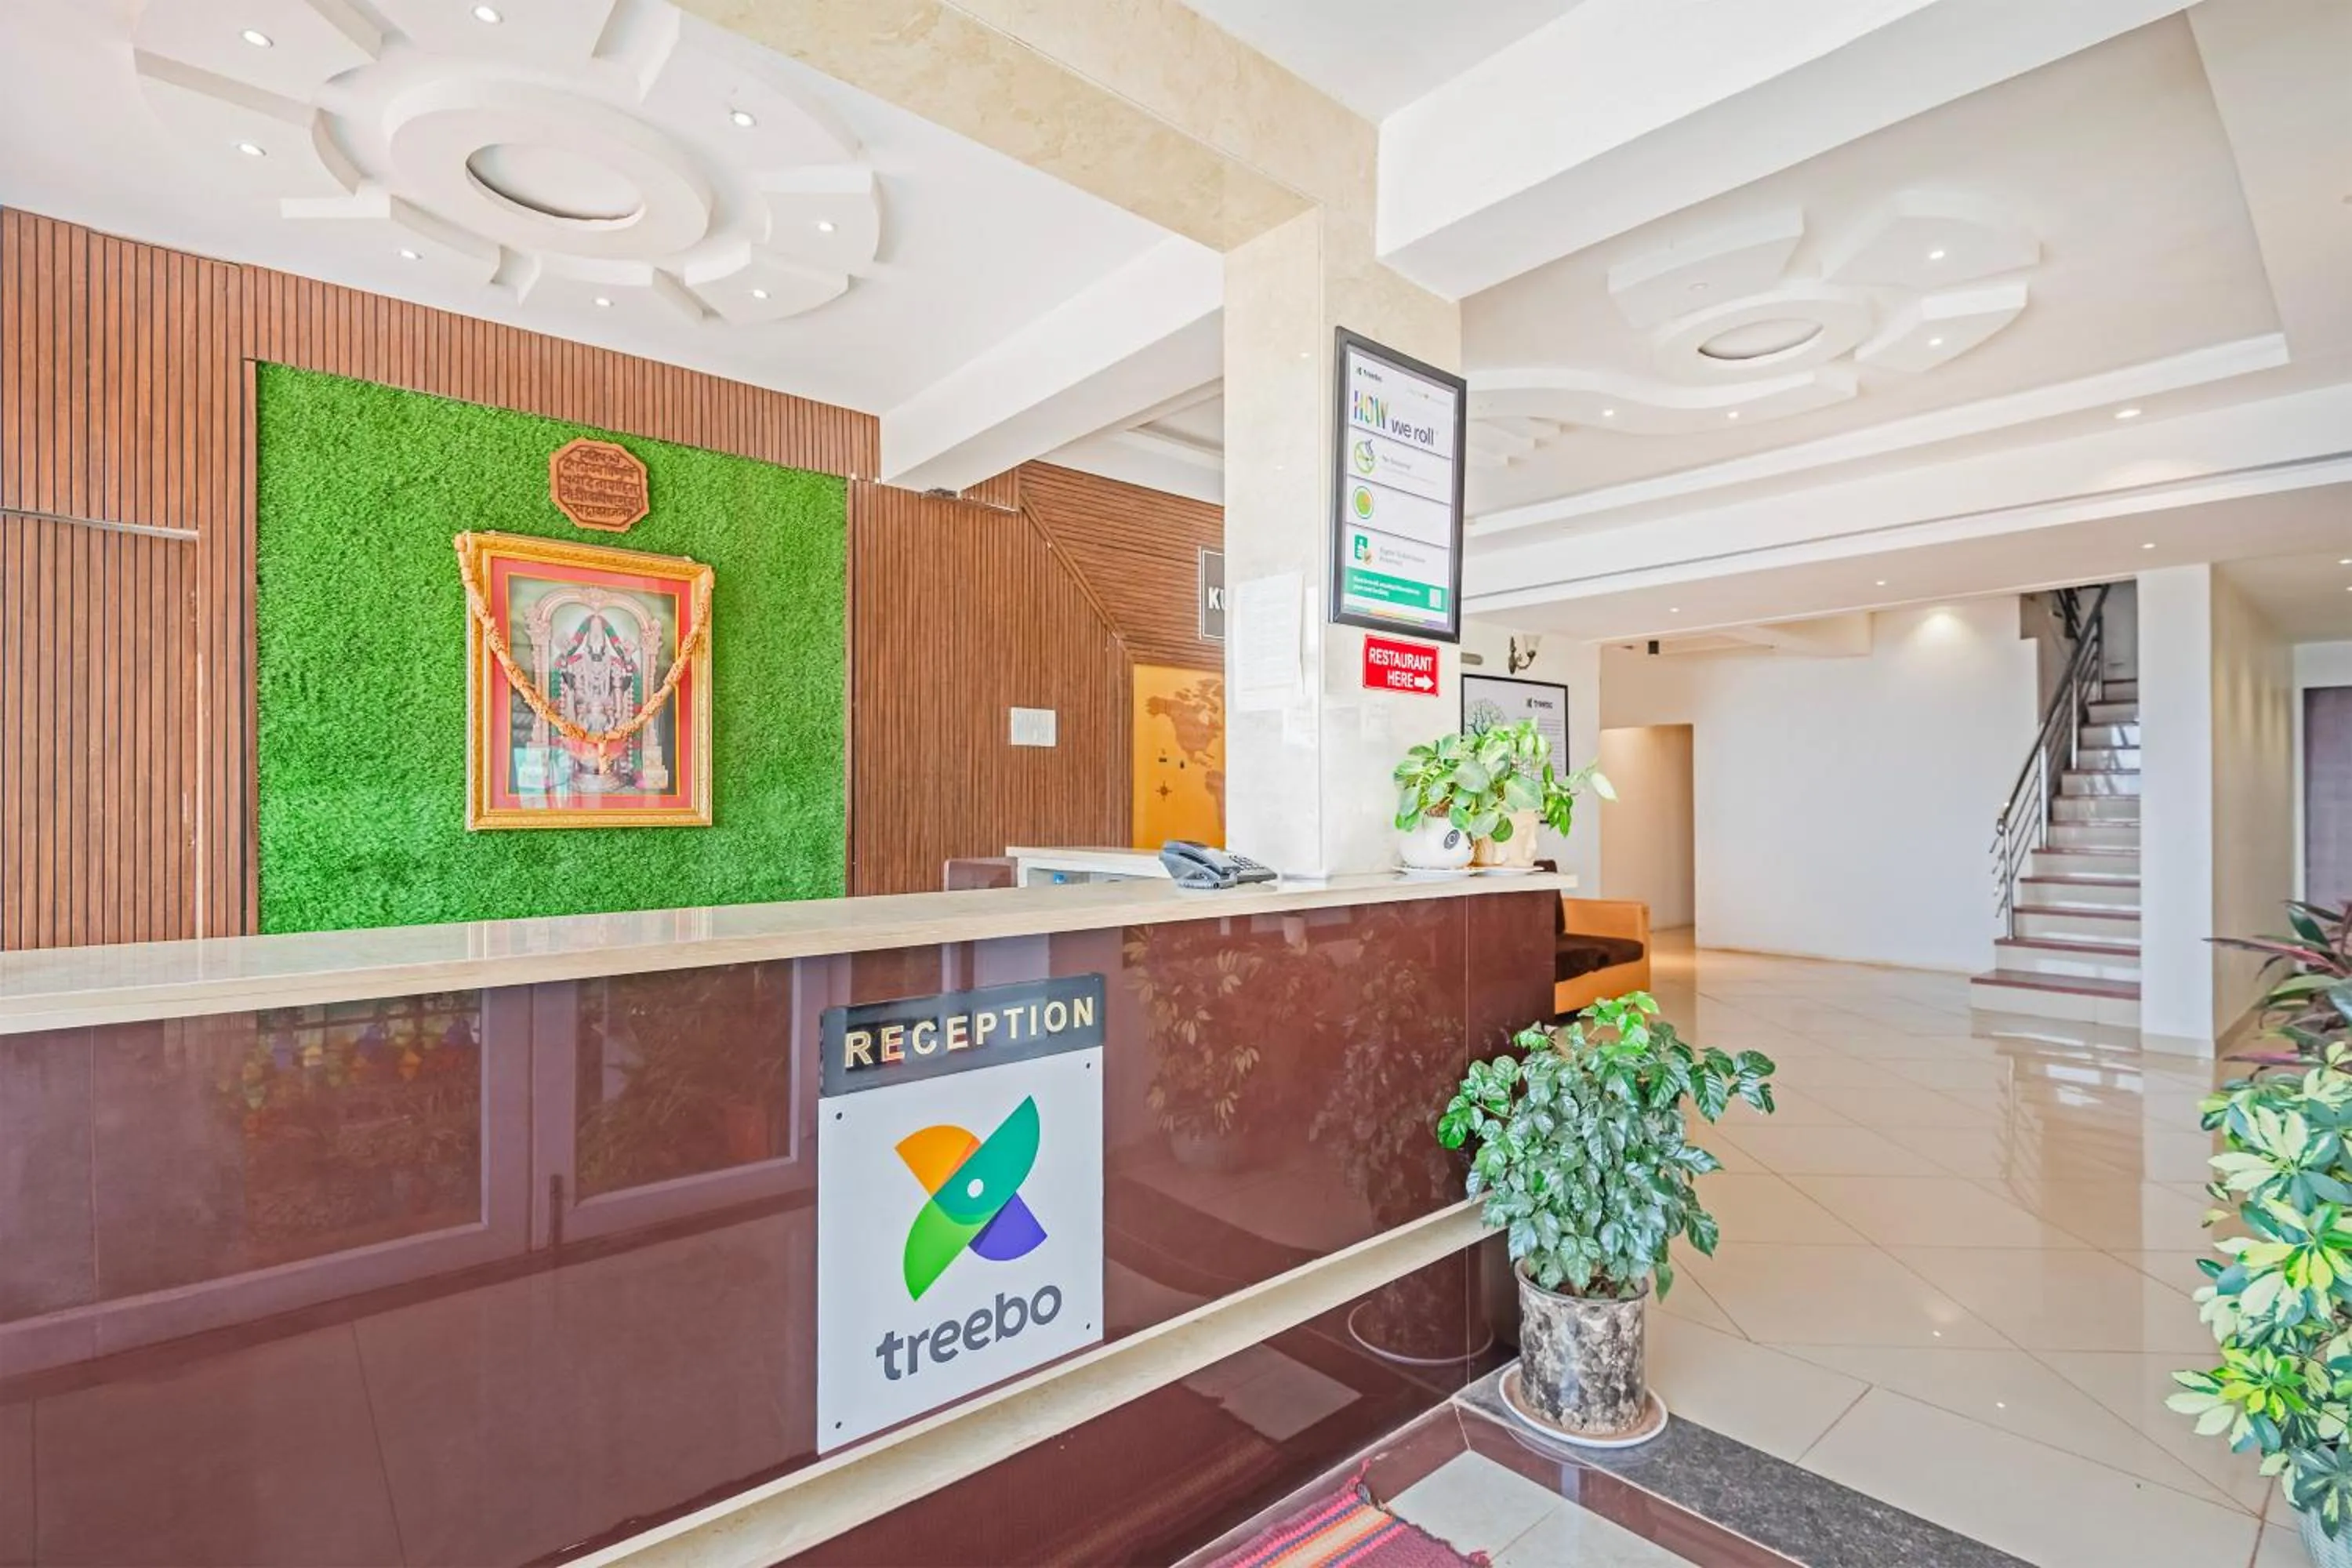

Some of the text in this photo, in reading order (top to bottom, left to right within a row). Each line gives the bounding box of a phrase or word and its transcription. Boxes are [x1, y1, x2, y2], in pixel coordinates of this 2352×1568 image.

[1392, 419, 1412, 438] we
[1414, 426, 1435, 446] roll
[1368, 647, 1433, 672] RESTAURANT
[1387, 670, 1414, 688] HERE
[844, 996, 1094, 1069] RECEPTION
[876, 1284, 1063, 1381] treebo
